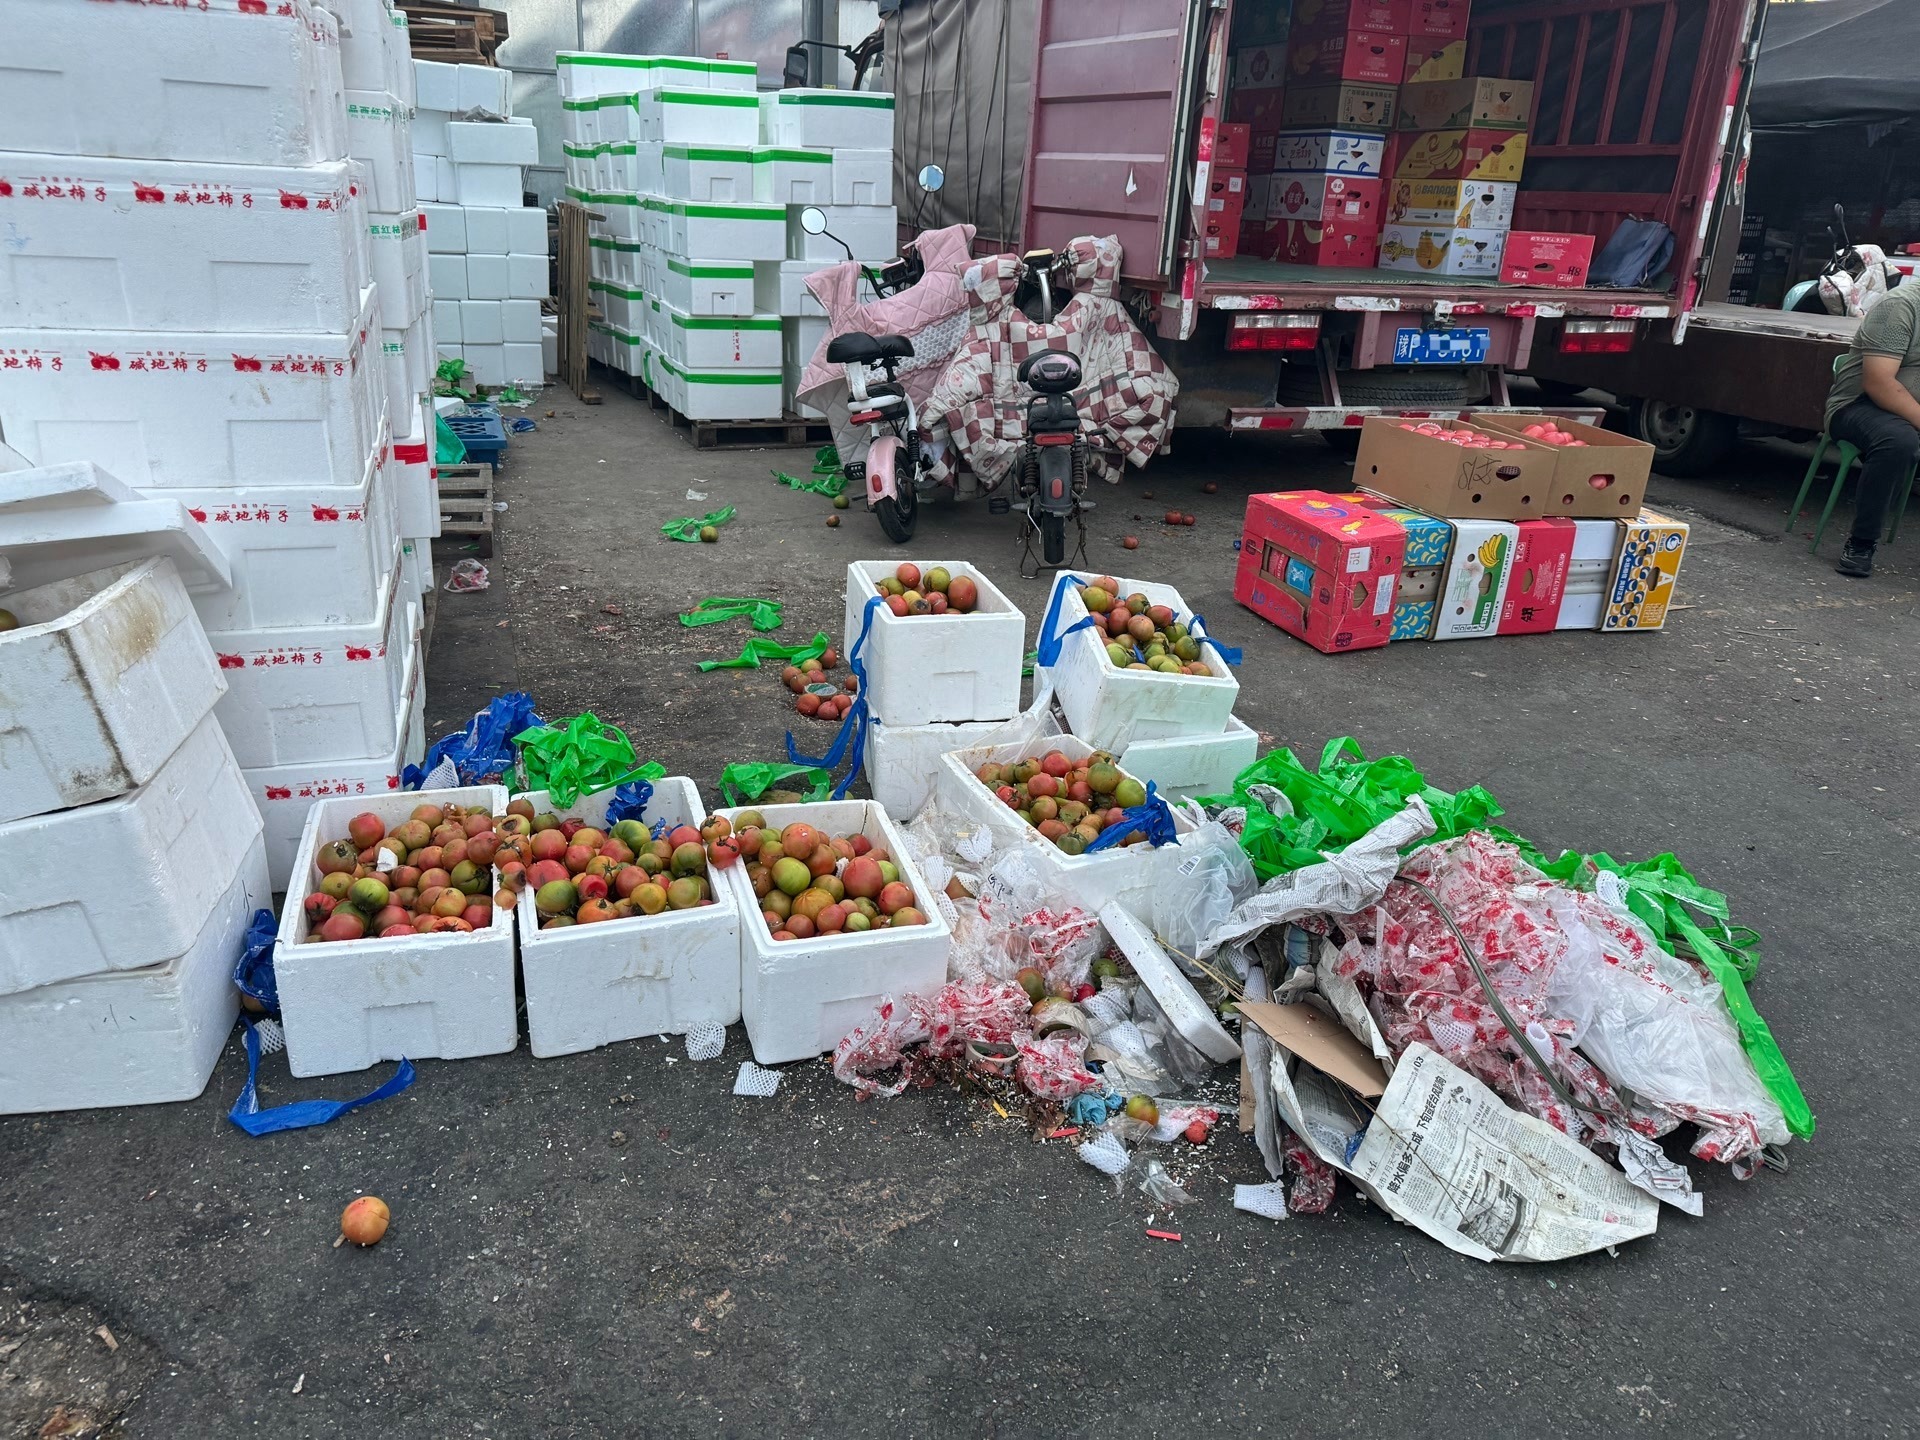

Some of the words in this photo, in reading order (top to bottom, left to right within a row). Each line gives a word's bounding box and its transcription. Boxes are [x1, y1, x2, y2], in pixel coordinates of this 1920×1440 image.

[23, 183, 107, 202] 碱地柿子
[173, 189, 254, 208] 碱地柿子
[129, 357, 208, 373] 碱地柿子
[270, 361, 344, 376] 碱地柿子
[215, 509, 289, 524] 碱地柿子
[253, 652, 323, 667] 碱地柿子
[298, 782, 366, 798] 碱地柿子
[1413, 1056, 1425, 1068] 03
[1387, 1131, 1424, 1195] 降水偏多二成
[1416, 1075, 1447, 1130] 下旬或受台风影响
